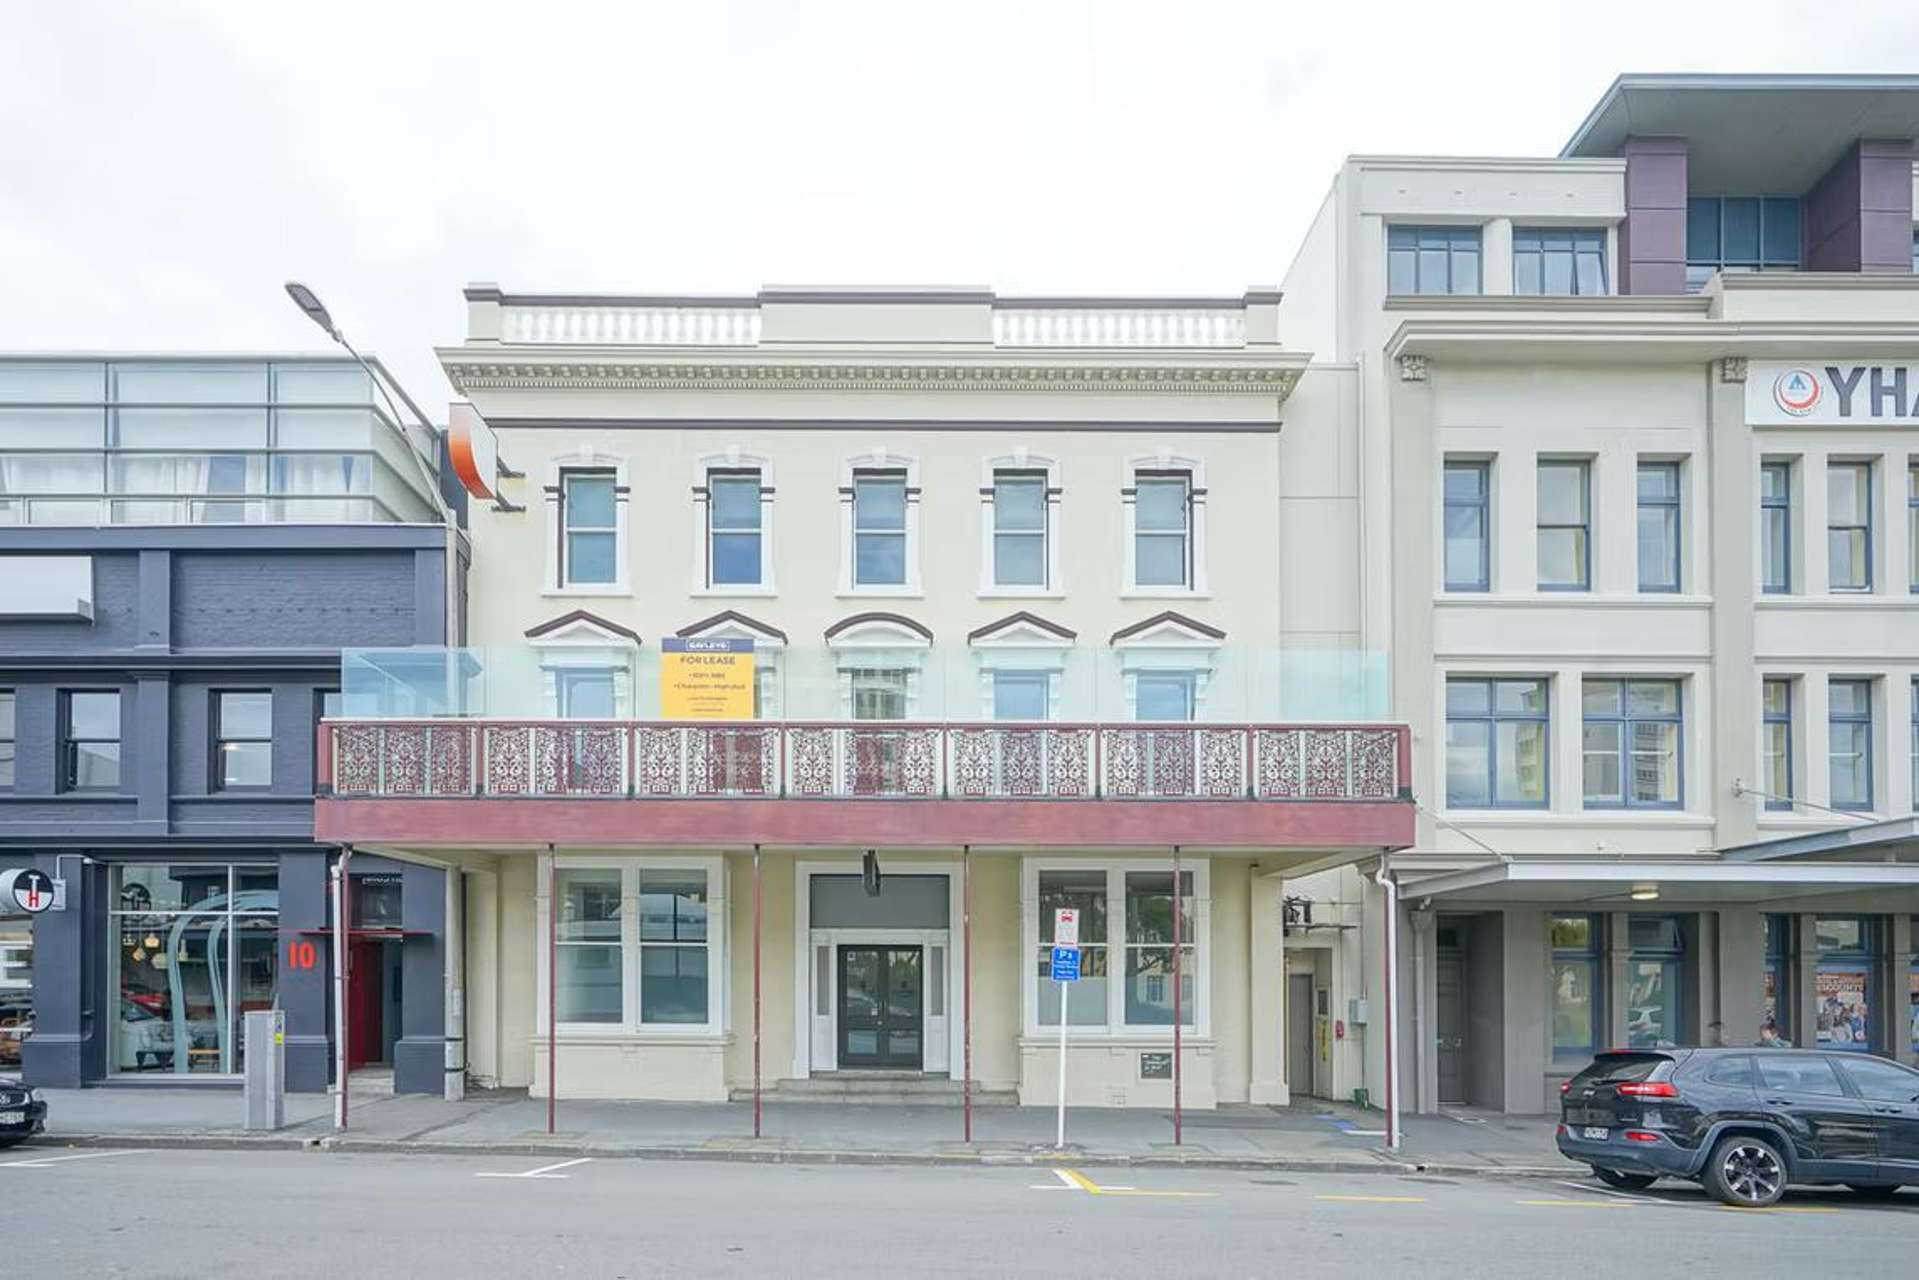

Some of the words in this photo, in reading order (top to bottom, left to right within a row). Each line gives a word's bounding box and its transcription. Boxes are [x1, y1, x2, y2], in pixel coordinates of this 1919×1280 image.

[1825, 366, 1919, 417] YH
[680, 656, 702, 665] FOR
[703, 656, 736, 665] LEASE
[289, 940, 316, 969] 10
